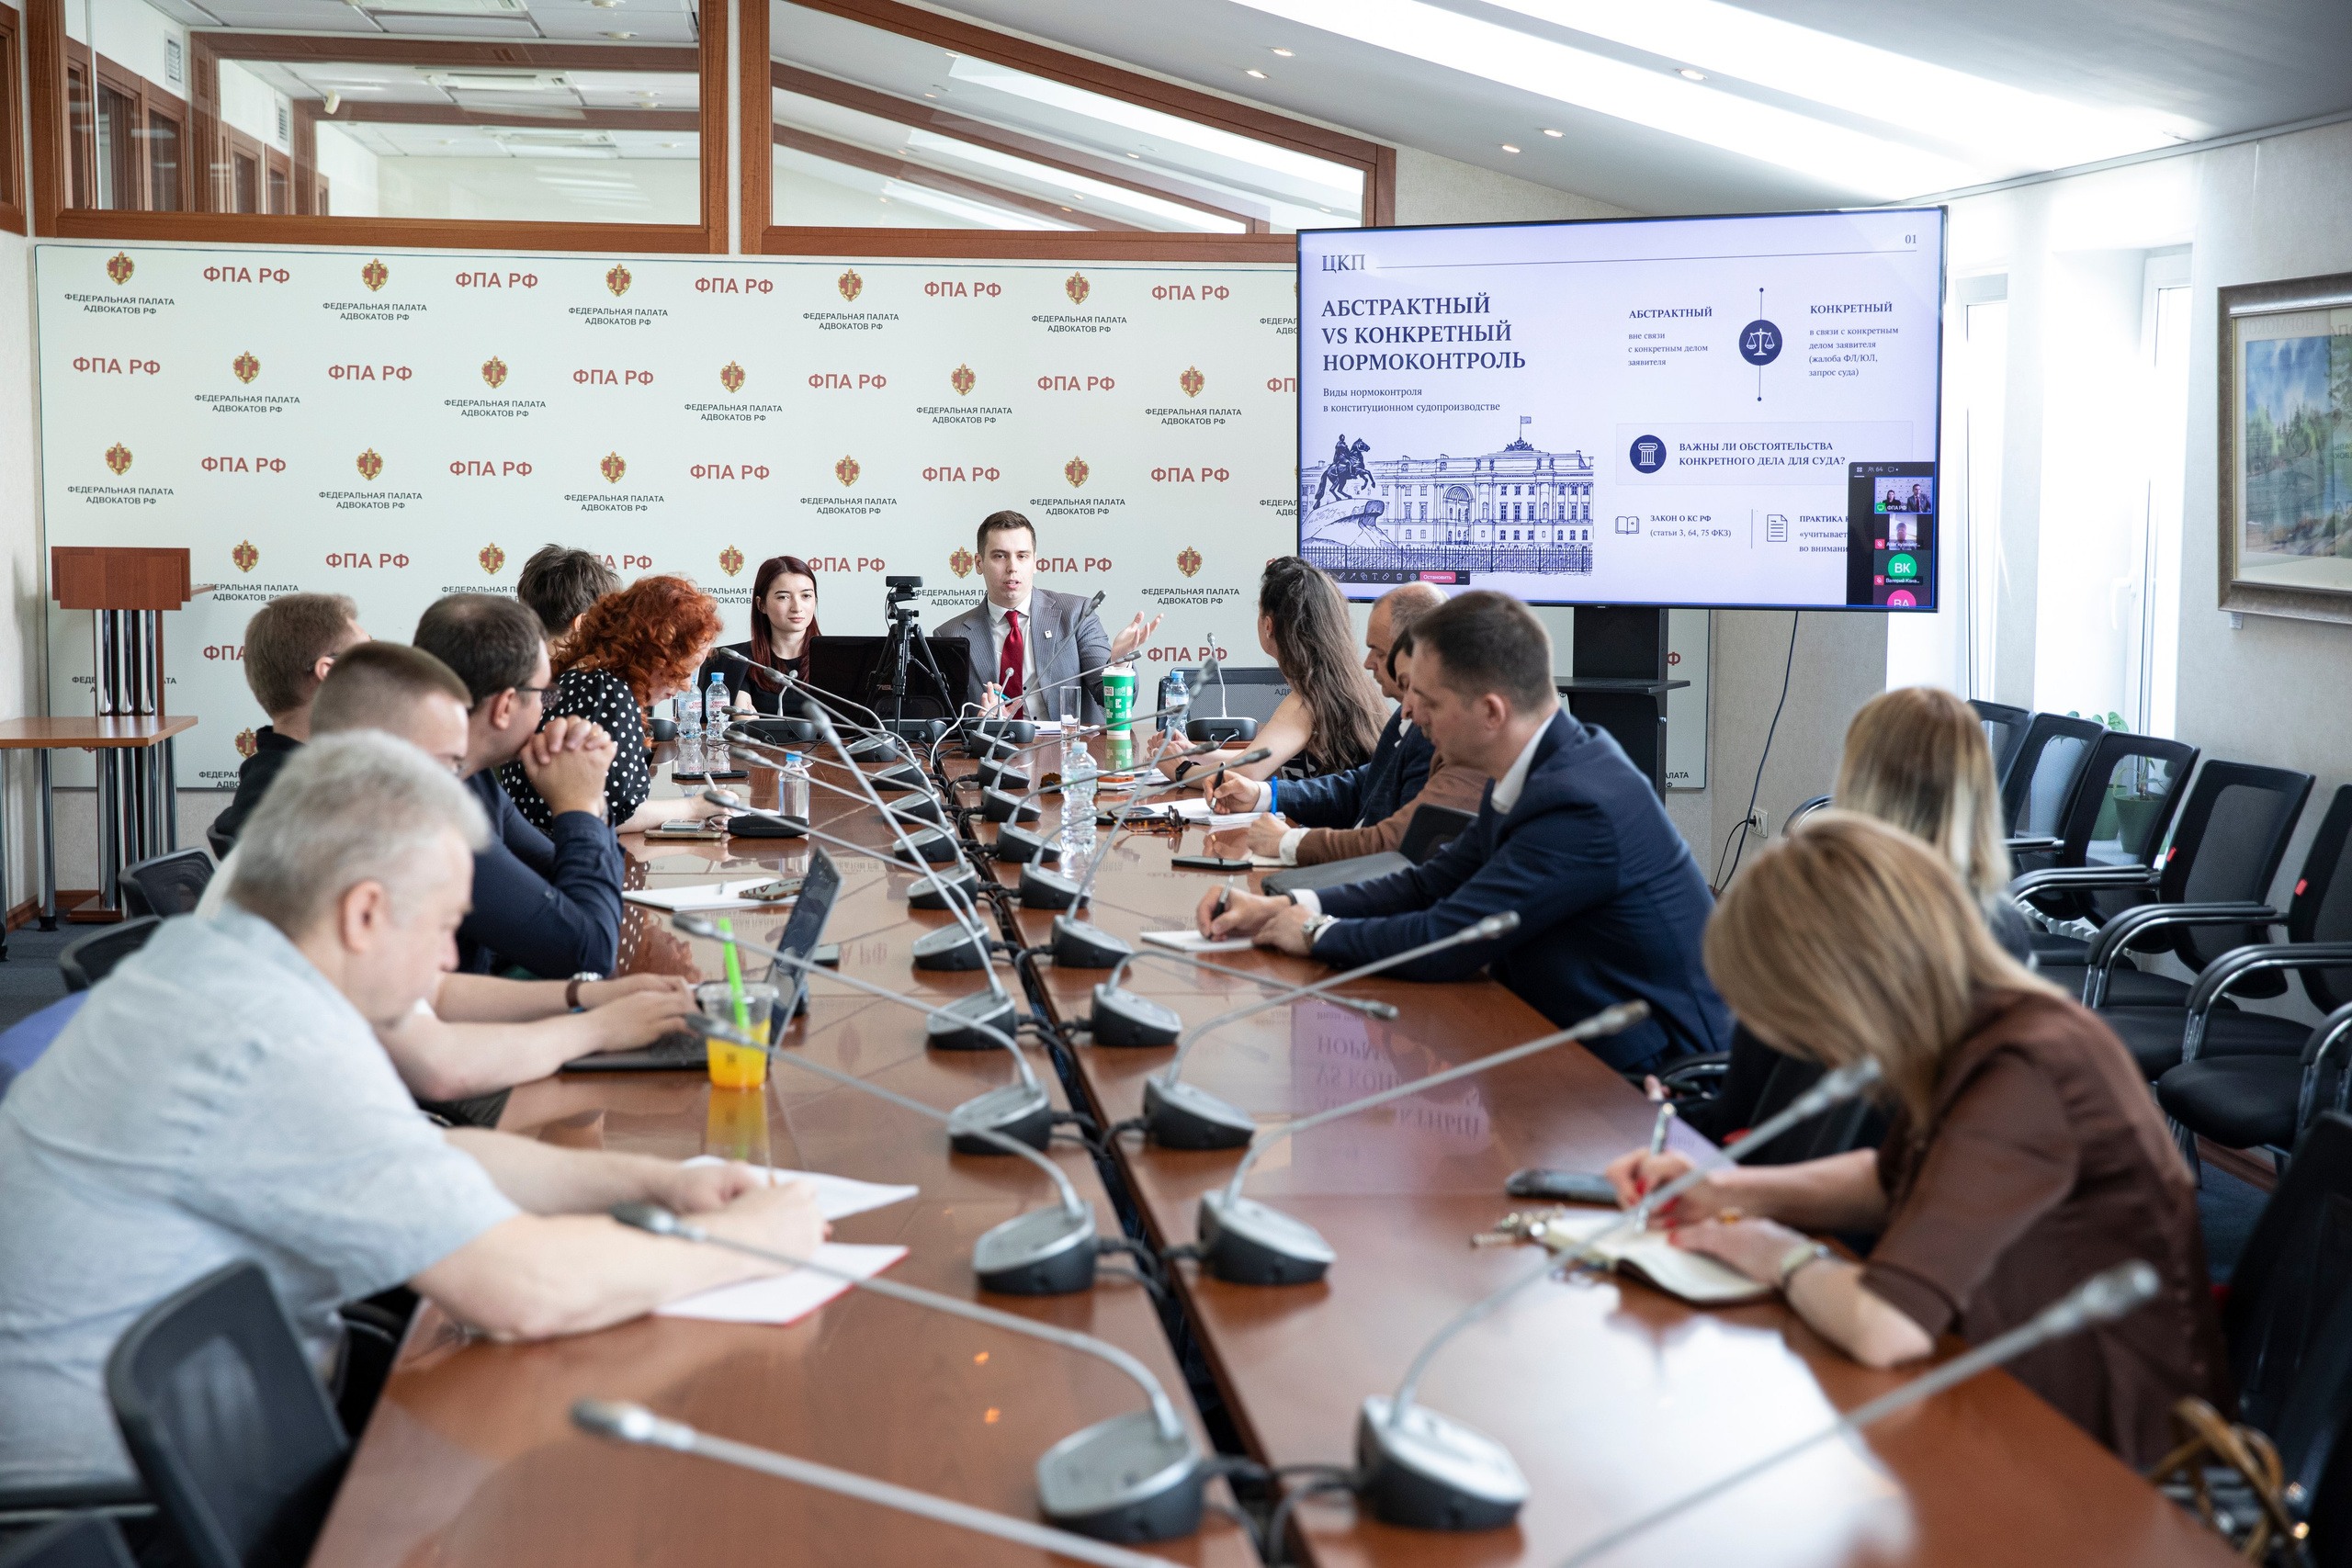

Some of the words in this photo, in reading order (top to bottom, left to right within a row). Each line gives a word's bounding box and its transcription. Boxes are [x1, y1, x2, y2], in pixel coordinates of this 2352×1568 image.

[1905, 234, 1917, 243] 01
[1322, 254, 1365, 275] ЦКП
[203, 265, 253, 284] ФПА
[258, 267, 290, 284] РФ
[455, 271, 503, 288] ФПА
[508, 272, 538, 289] РФ
[695, 276, 740, 294] ФПА
[745, 278, 774, 295] РФ
[923, 281, 968, 298] ФПА
[973, 282, 1002, 299] РФ
[1151, 285, 1196, 300] ФПА
[1201, 285, 1230, 301] РФ
[322, 302, 390, 310] ФЕДЕРАЛЬНАЯ
[1321, 291, 1491, 317] АБСТРАКТНЫЙ
[1811, 300, 1893, 314] КОНКРЕТНЫЙ
[568, 307, 633, 315] ФЕДЕРАЛЬНАЯ
[634, 308, 669, 316] ПАЛАТА
[1630, 306, 1713, 318] АБСТРАКТНЫЙ
[584, 317, 637, 325] АДВОКАТОВ
[1046, 324, 1098, 333] АДВОКАТОВ
[1321, 327, 1348, 344] VS
[1355, 319, 1512, 344] КОНКРЕТНЫЙ
[1848, 328, 1899, 336] конкретным
[1634, 345, 1682, 354] конкретным
[1323, 351, 1526, 372] НОРМОКОНТРОЛЬ
[1809, 354, 1842, 364] (жалоба
[73, 356, 122, 375] ФПА
[130, 359, 161, 376] РФ
[328, 364, 376, 381] ФПА
[382, 365, 413, 381] РФ
[572, 368, 618, 385] ФПА
[625, 369, 654, 386] РФ
[1809, 369, 1837, 378] запрос
[1838, 367, 1860, 377] суда)
[808, 373, 853, 389] ФПА
[858, 374, 887, 389] РФ
[1037, 376, 1081, 391] ФПА
[1087, 376, 1115, 391] РФ
[194, 394, 263, 402] ФЕДЕРАЛЬНАЯ
[1324, 388, 1348, 397] Виды
[1351, 389, 1422, 398] нормоконтроля
[211, 404, 267, 412] АДВОКАТОВ
[444, 399, 510, 407] ФЕДЕРАЛЬНАЯ
[684, 403, 748, 412] ФЕДЕРАЛЬНАЯ
[1331, 404, 1414, 413] конституционном
[1417, 403, 1500, 413] судопроизводстве
[460, 409, 514, 417] АДВОКАТОВ
[916, 406, 978, 414] ФЕДЕРАЛЬНАЯ
[1160, 417, 1212, 425] АДВОКАТОВ
[1722, 442, 1736, 450] ЛИ
[1740, 442, 1833, 450] ОБСТОЯТЕЛЬСТВА
[201, 457, 249, 473] ФПА
[255, 457, 287, 473] РФ
[1679, 457, 1756, 465] КОНКРЕТНОГО
[1758, 457, 1785, 466] ДЕЛА
[1788, 457, 1809, 466] ДЛЯ
[1813, 457, 1846, 466] СУДА?
[449, 460, 497, 477] ФПА
[503, 461, 533, 477] РФ
[690, 464, 736, 480] ФПА
[741, 464, 770, 480] РФ
[922, 466, 967, 482] ФПА
[972, 467, 1001, 482] РФ
[1150, 467, 1195, 482] ФПА
[1201, 468, 1230, 483] РФ
[563, 493, 629, 502] ФЕДЕРАЛЬНАЯ
[799, 497, 863, 505] ФЕДЕРАЛЬНАЯ
[1029, 498, 1091, 506] ФЕДЕРАЛЬНАЯ
[335, 501, 390, 509] АДВОКАТОВ
[816, 506, 867, 514] АДВОКАТОВ
[1045, 507, 1096, 515] АДВОКАТОВ
[1650, 528, 1678, 536] (статьи
[1702, 528, 1710, 536] 75
[1712, 528, 1732, 537] ФКЗ)
[325, 552, 373, 569] ФПА
[379, 553, 410, 569] РФ
[807, 557, 852, 572] ФПА
[857, 558, 886, 572] РФ
[1035, 558, 1079, 573] ФПА
[1084, 557, 1113, 572] РФ
[1894, 563, 1911, 573] ВК
[1147, 647, 1193, 662] ФПА
[1198, 647, 1228, 662] РФ
